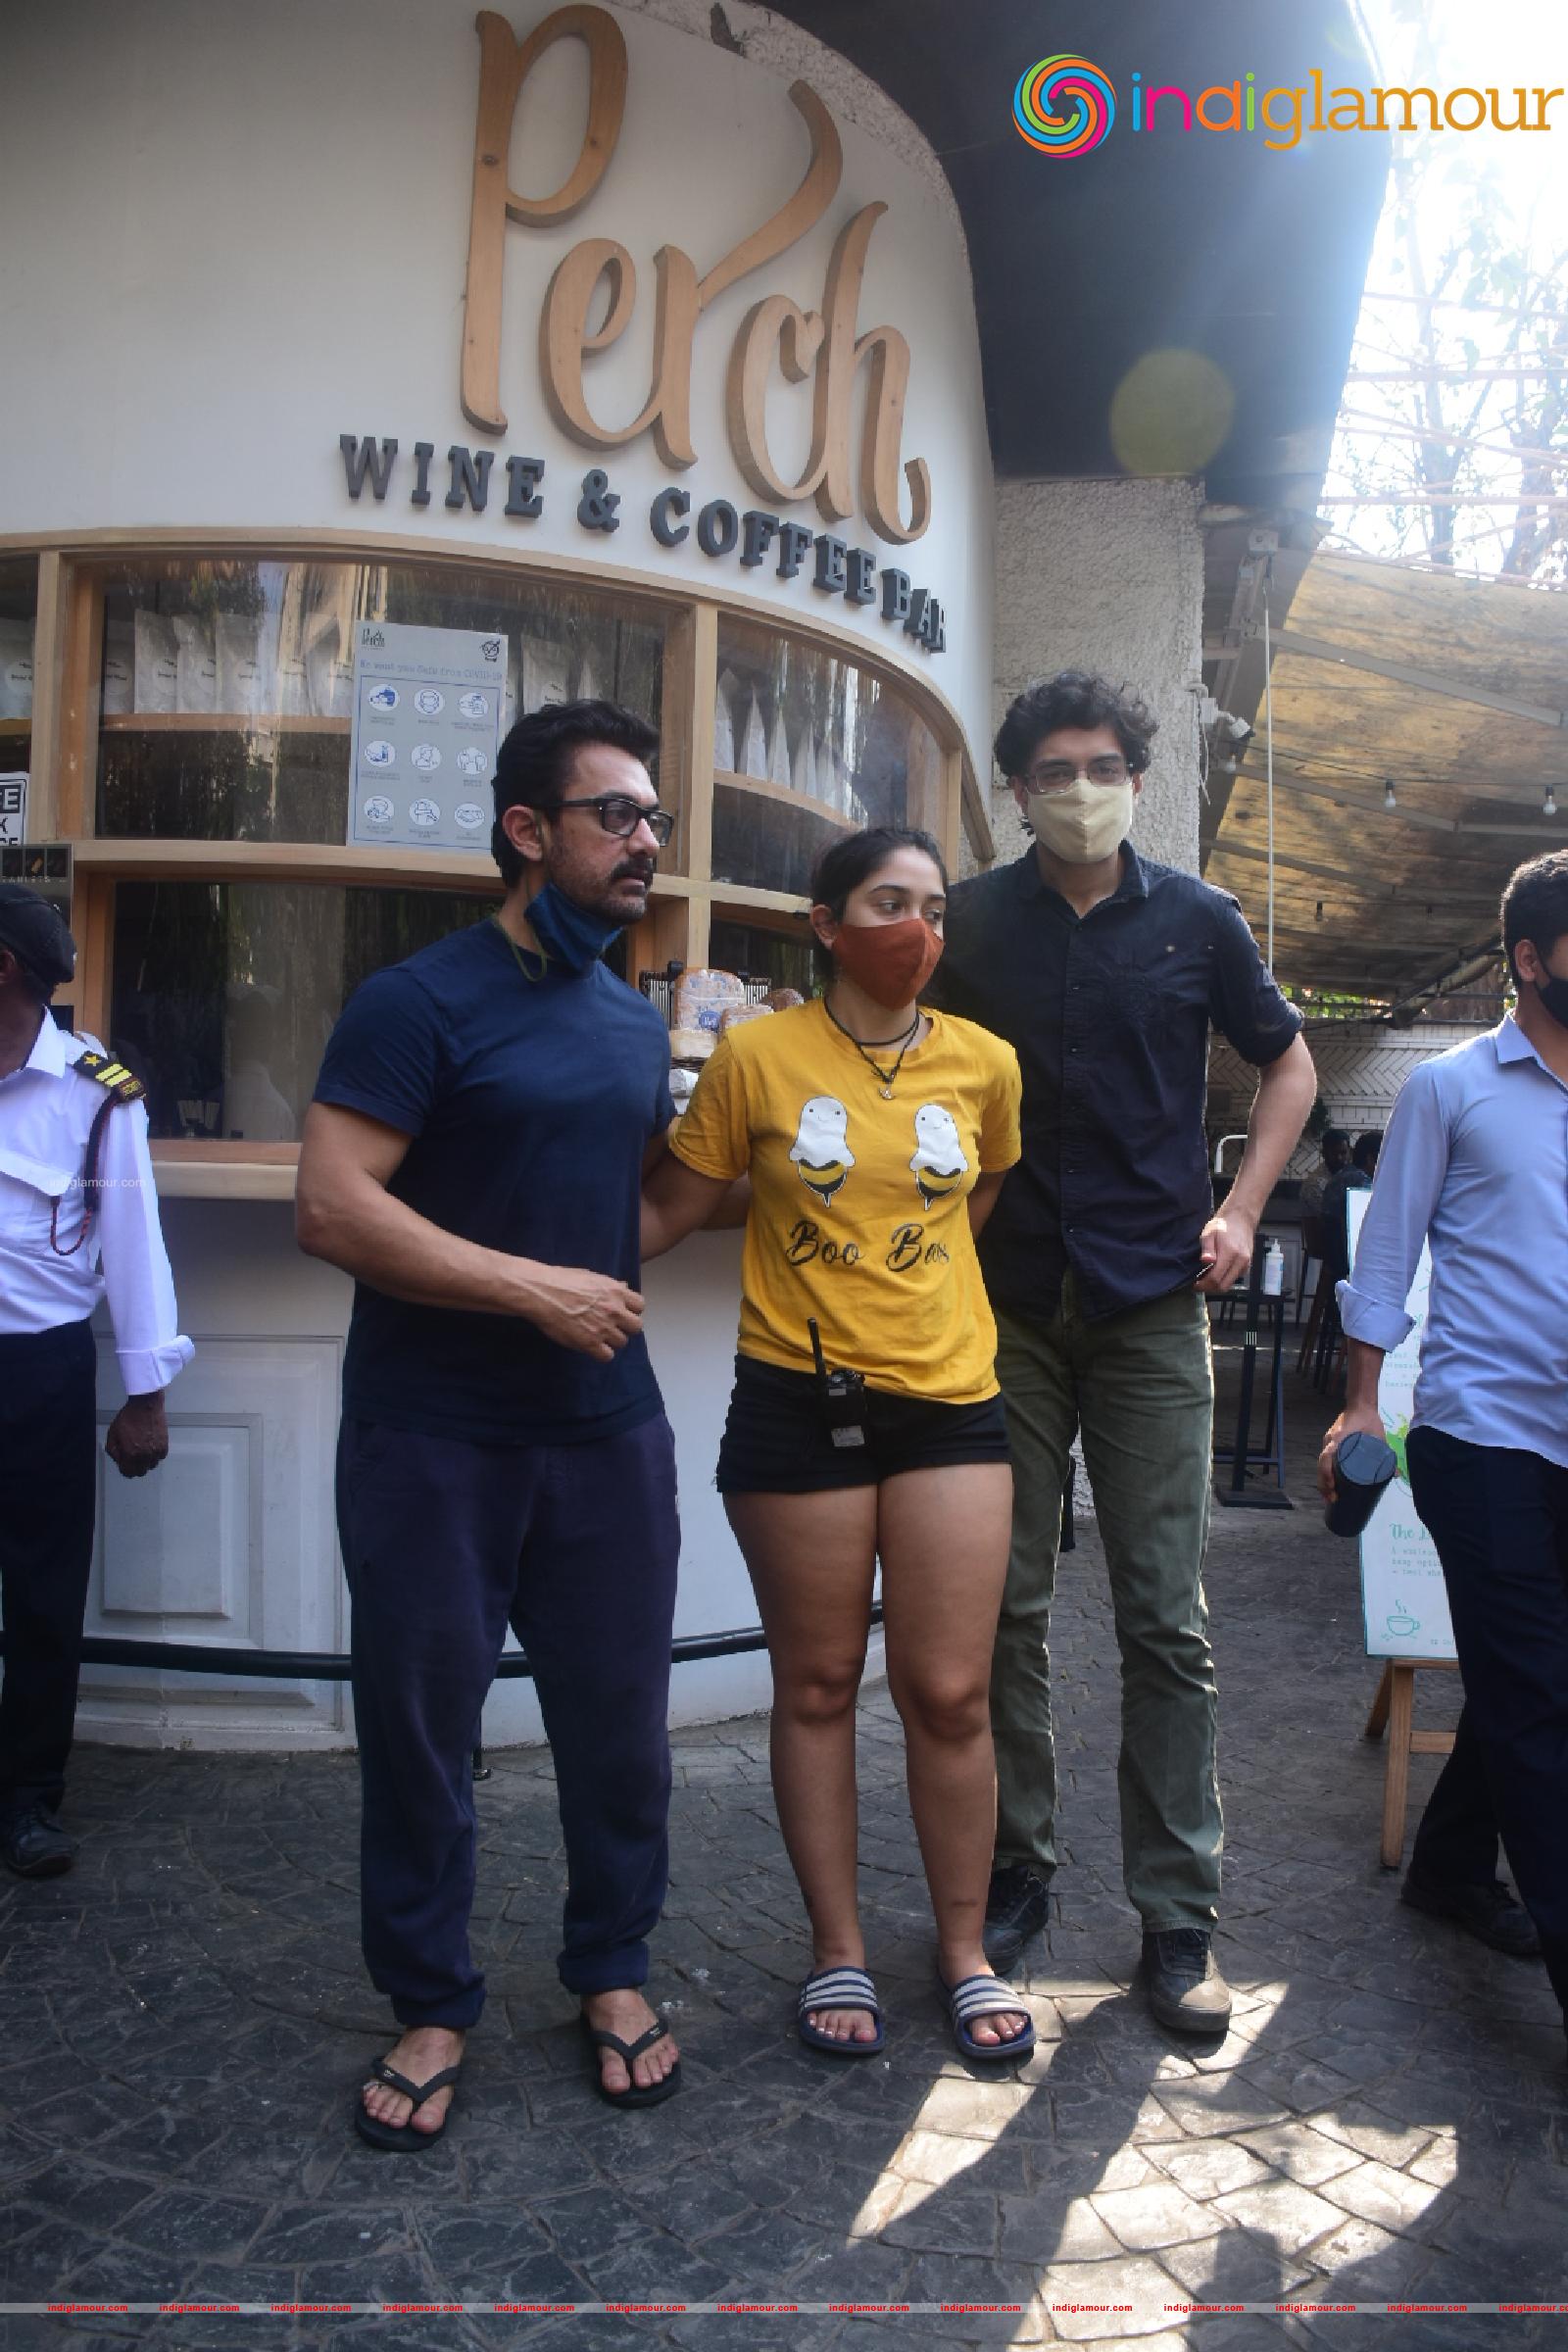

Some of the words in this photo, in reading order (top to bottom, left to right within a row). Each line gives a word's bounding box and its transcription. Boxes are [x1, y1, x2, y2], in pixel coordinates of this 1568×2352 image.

[461, 4, 931, 546] Perch
[340, 434, 545, 518] WINE
[577, 468, 621, 533] &
[650, 486, 877, 605] COFFEE
[880, 567, 947, 654] BAR
[786, 1218, 864, 1267] Boo
